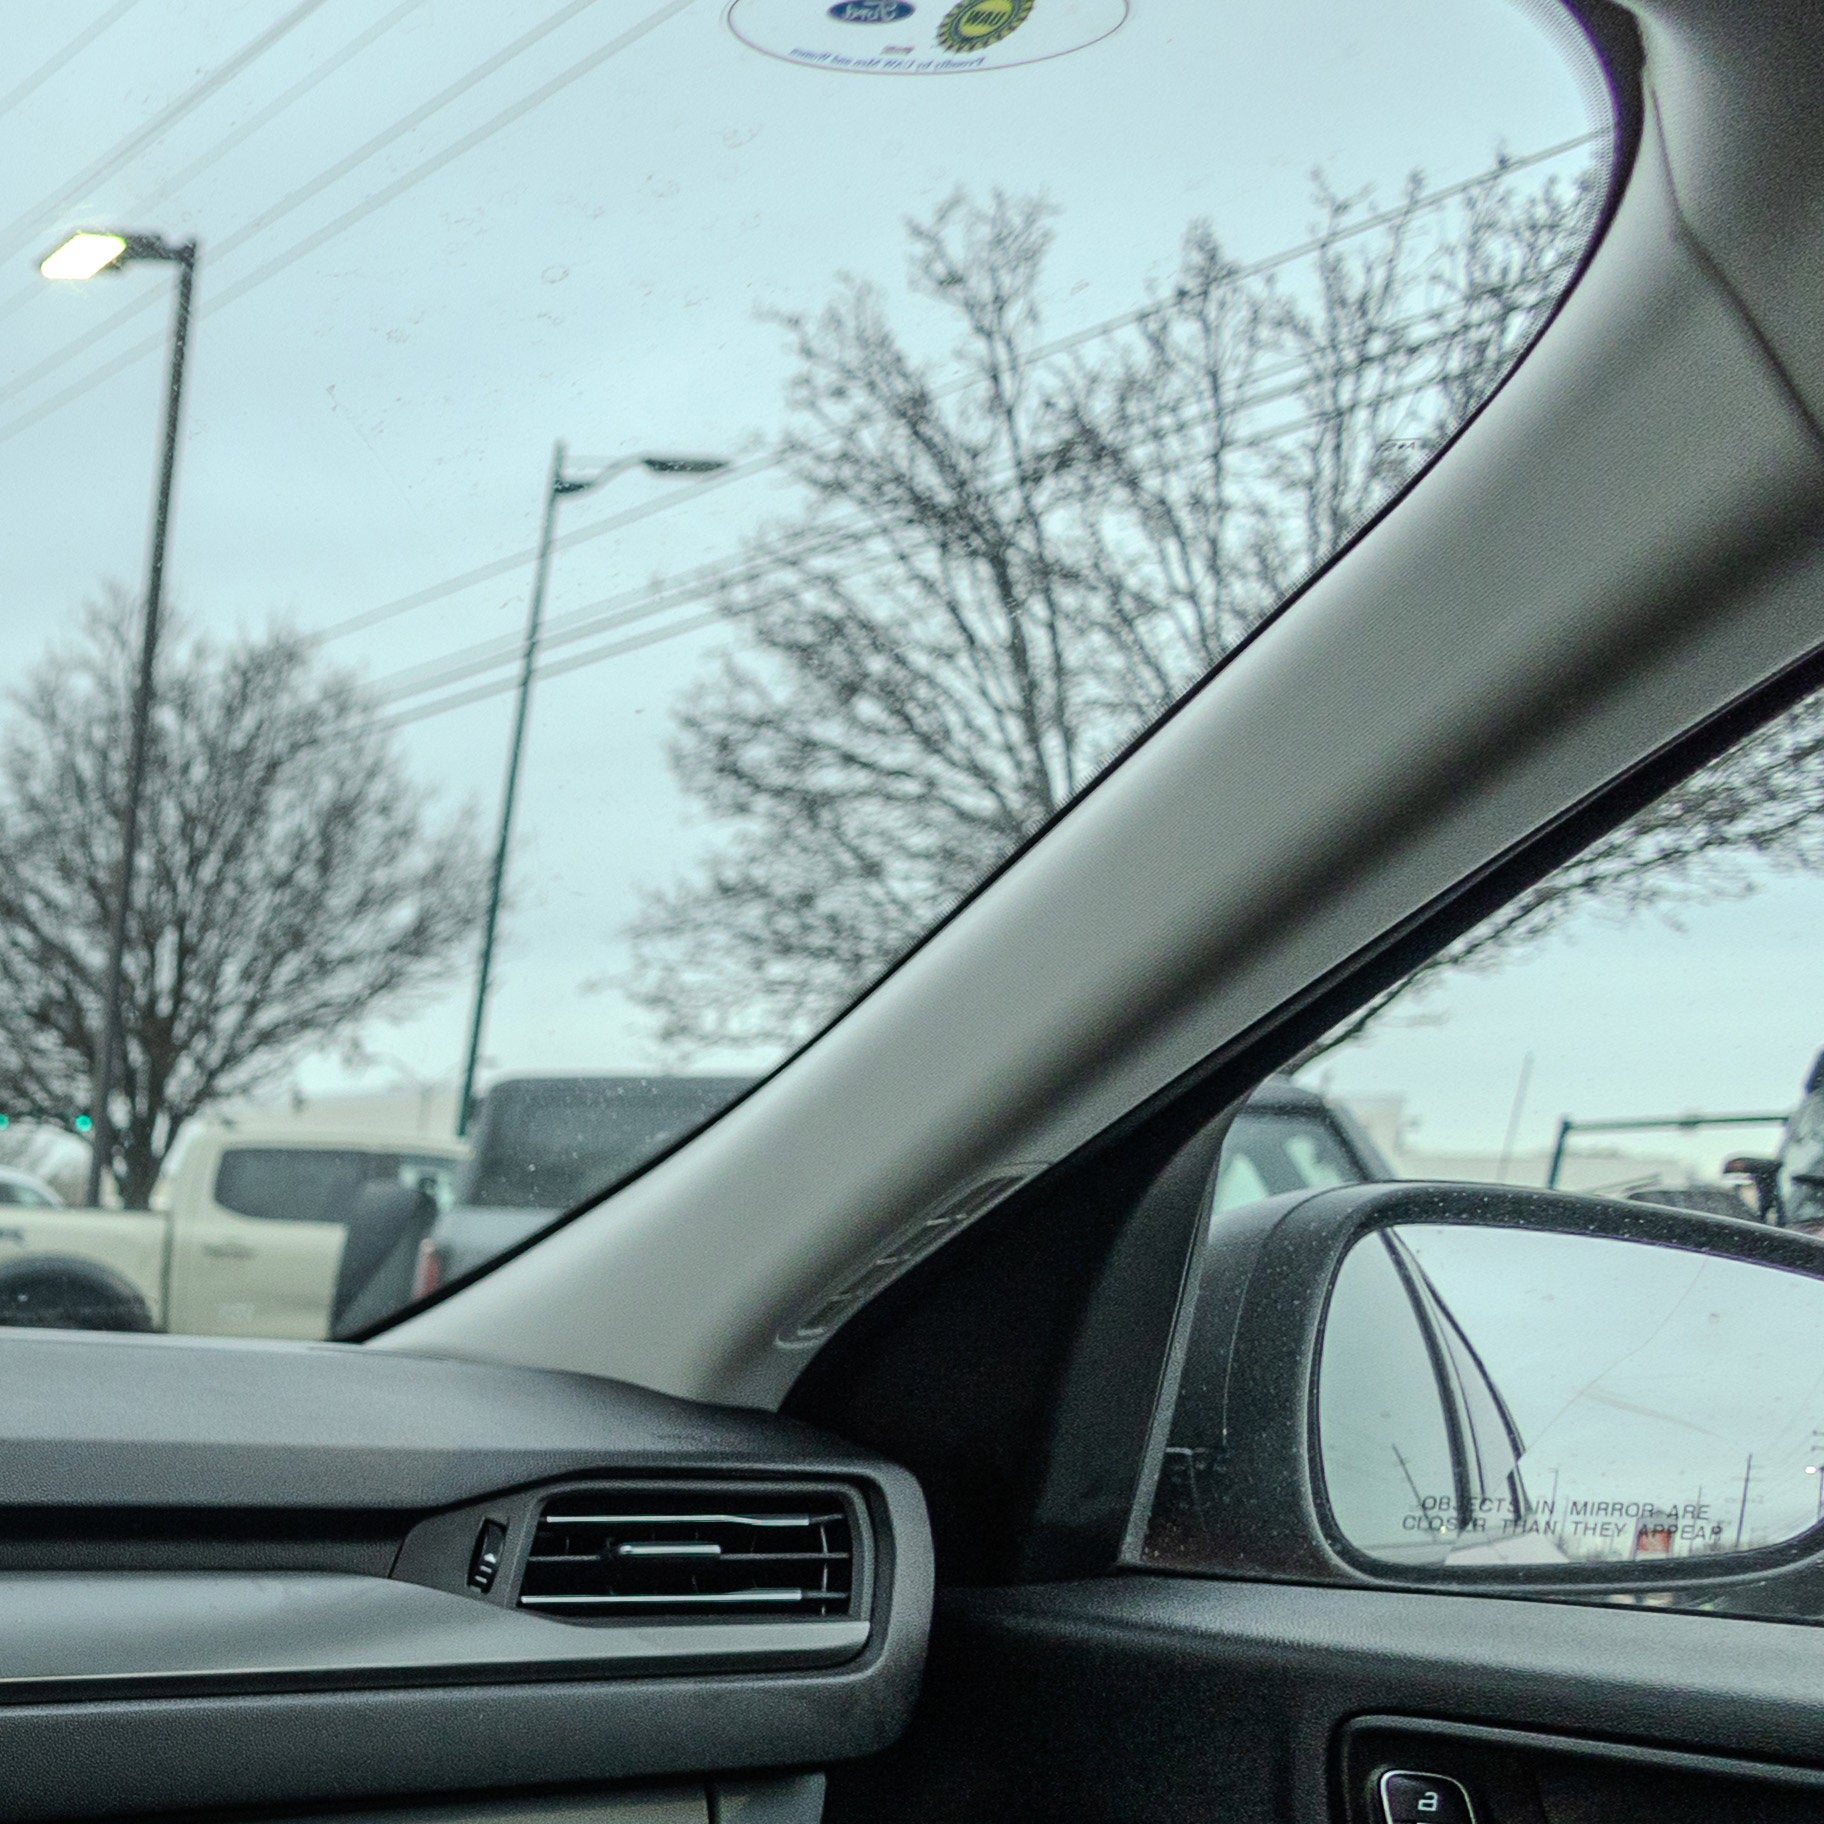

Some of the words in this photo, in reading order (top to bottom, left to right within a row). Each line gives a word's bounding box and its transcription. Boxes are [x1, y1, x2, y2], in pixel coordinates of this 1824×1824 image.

[1421, 1495, 1518, 1514] OBECTS
[1569, 1501, 1655, 1519] MIRROR
[1667, 1504, 1711, 1521] ARE
[1572, 1520, 1627, 1537] THEY
